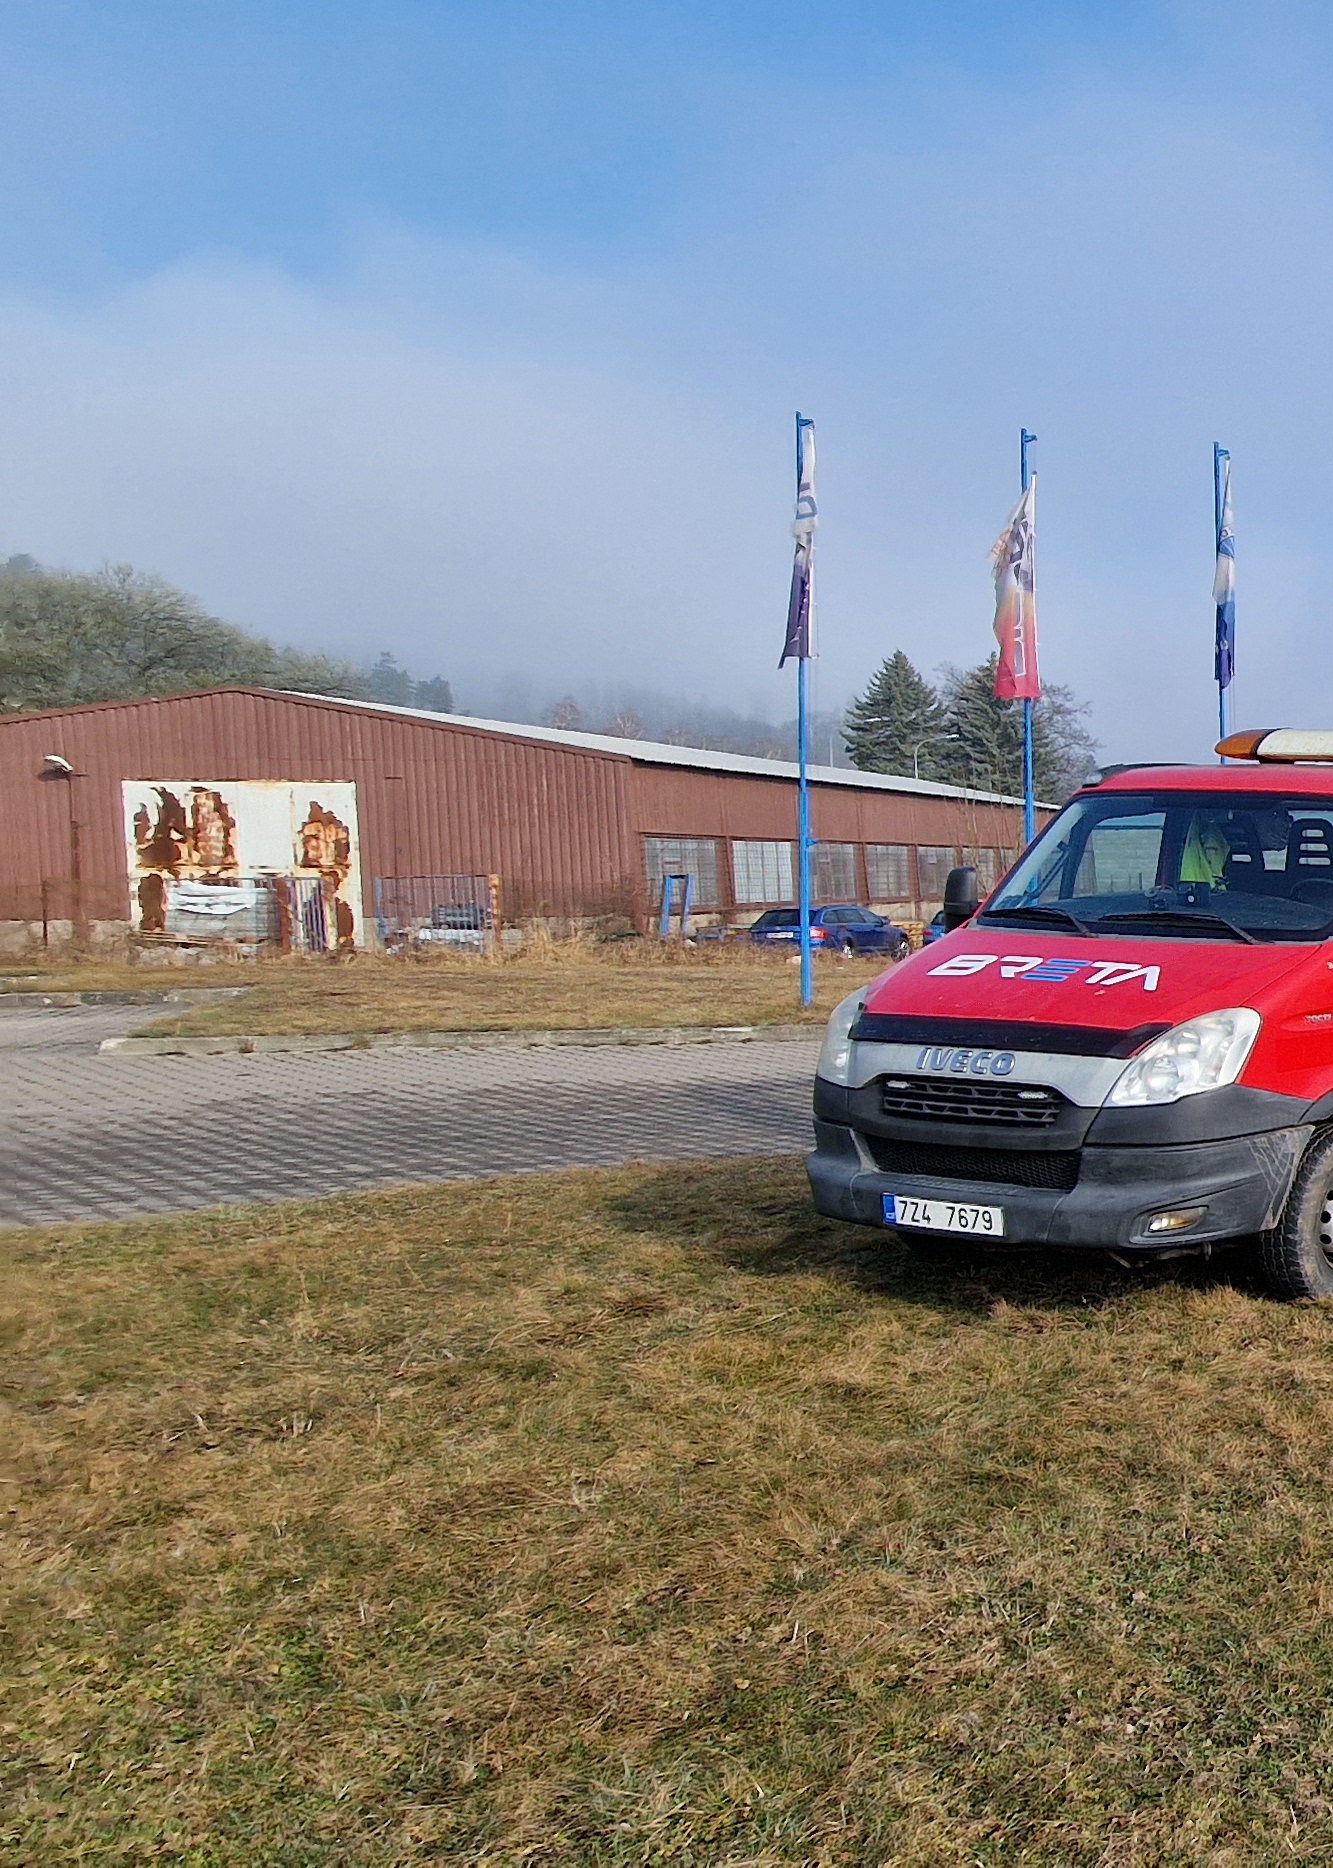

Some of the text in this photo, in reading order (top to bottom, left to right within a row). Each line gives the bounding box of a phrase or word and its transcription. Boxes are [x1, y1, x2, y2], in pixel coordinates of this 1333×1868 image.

[926, 954, 1161, 991] BRETA
[916, 1047, 1016, 1076] IVECO
[899, 1200, 993, 1231] 7Z4 7679
